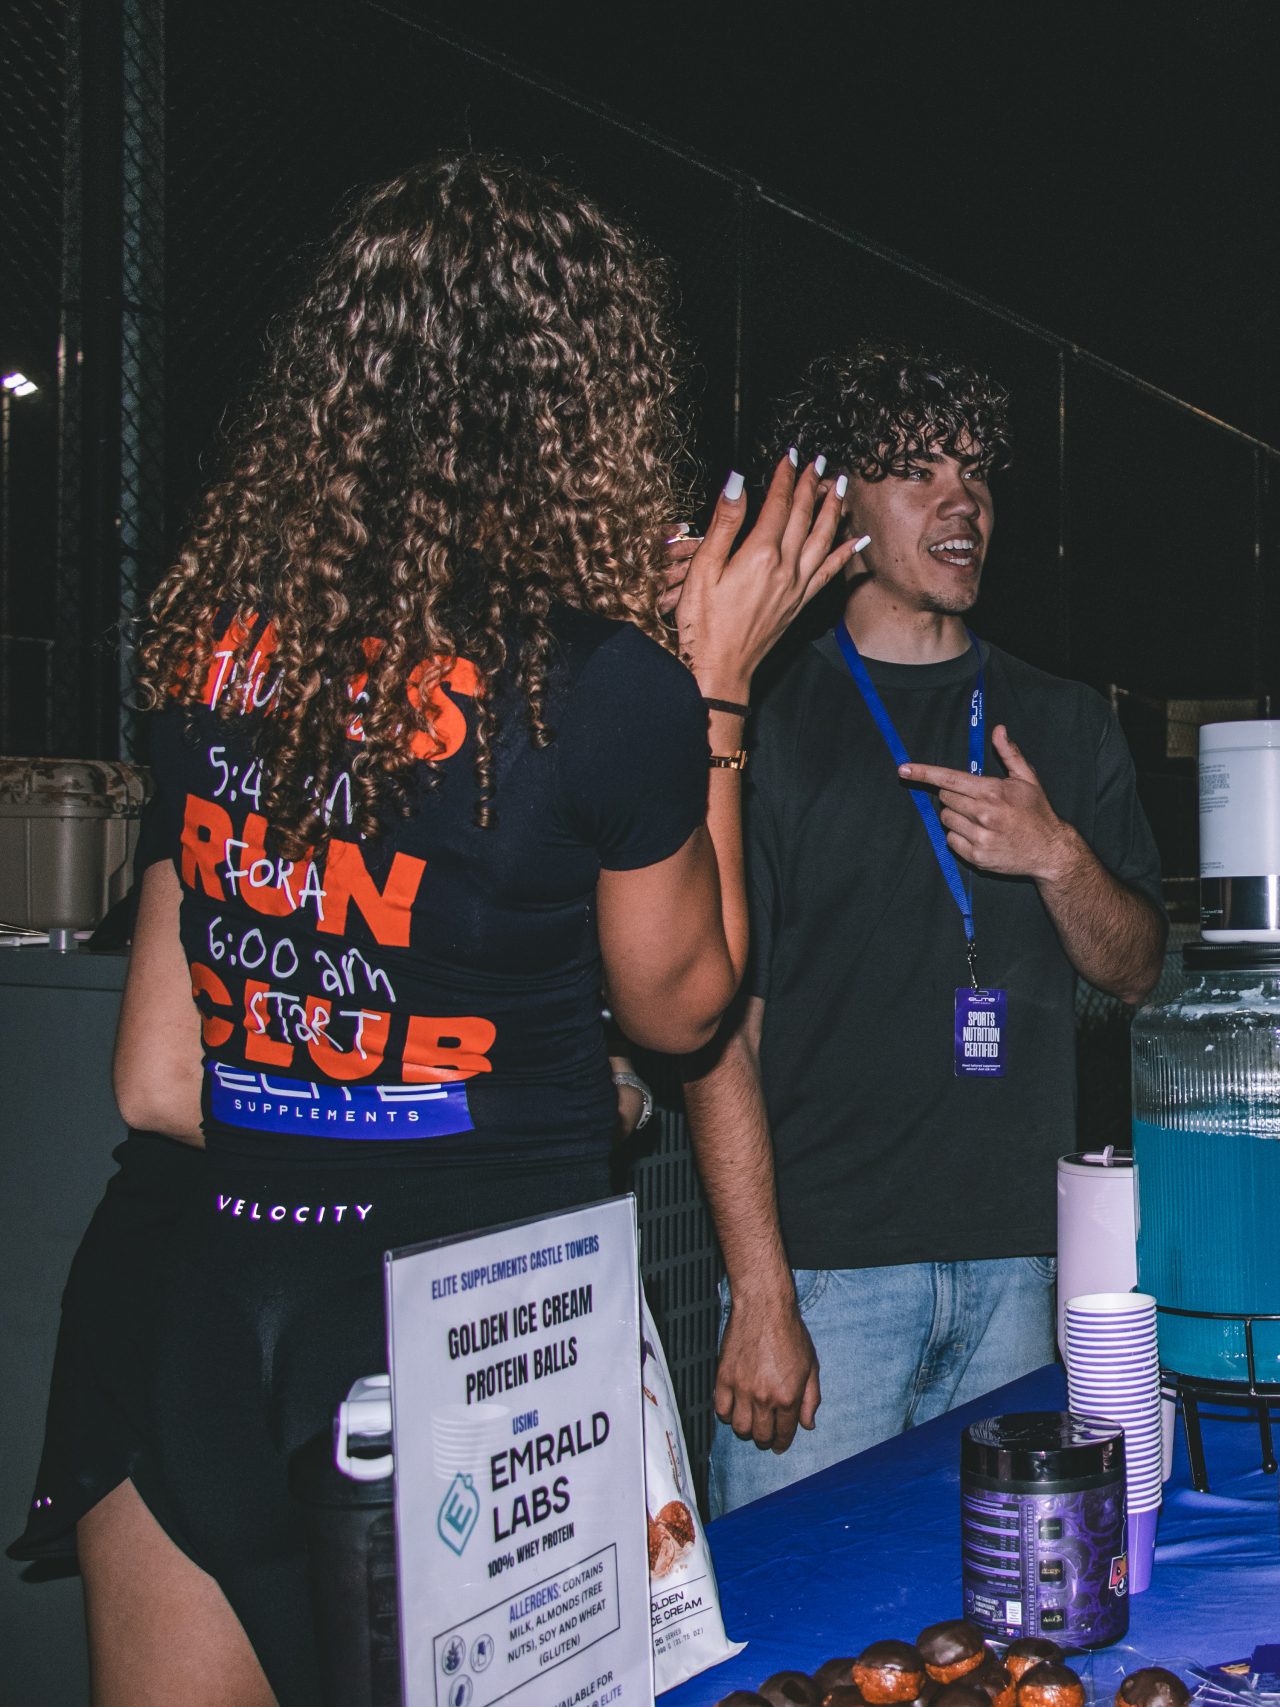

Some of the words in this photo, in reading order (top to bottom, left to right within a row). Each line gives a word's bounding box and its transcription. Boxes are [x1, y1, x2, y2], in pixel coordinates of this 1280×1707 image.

[181, 793, 427, 948] RUN
[208, 916, 299, 978] 6:00
[315, 947, 397, 1003] am
[191, 961, 497, 1084] CLUB
[963, 1026, 1000, 1042] NUTRITION
[968, 1011, 996, 1027] SPORTS
[964, 1042, 999, 1058] CERTIFIED
[235, 1099, 420, 1123] SUPPLEMENTS
[217, 1193, 373, 1224] VELOCITY
[431, 1274, 458, 1300] ELITE
[461, 1254, 528, 1292] SUPPLEMENTS
[530, 1244, 563, 1271] CASTLE
[565, 1234, 600, 1261] TOWERS
[448, 1310, 509, 1361] GOLDEN
[513, 1301, 538, 1339] ICE
[542, 1283, 593, 1329] CREAM
[466, 1353, 529, 1406] PROTEIN
[534, 1336, 578, 1381] BALLS
[512, 1409, 539, 1436] USING
[490, 1411, 610, 1492] EMRALD
[493, 1475, 571, 1543] LABS
[487, 1551, 515, 1579] 100%
[516, 1538, 540, 1564] WHEY
[542, 1521, 575, 1552] PROTEIN
[509, 1581, 562, 1625] ALLERGENS:
[562, 1562, 604, 1593] CONTAINS
[510, 1619, 535, 1642] MILK,
[535, 1596, 580, 1627] ALMONDS
[580, 1580, 604, 1605] (TREE
[651, 1591, 685, 1613] OLDEN
[651, 1614, 663, 1627] CE
[663, 1597, 703, 1620] CREAM
[507, 1640, 539, 1664] NUTS),
[539, 1628, 556, 1646] SOY
[558, 1614, 578, 1636] AND
[578, 1598, 607, 1626] WHEAT
[538, 1633, 581, 1667] (GLUTEN)
[654, 1636, 664, 1647] 26
[554, 1681, 596, 1707] AILABLE
[596, 1670, 614, 1690] FOR
[600, 1684, 623, 1706] ELITE
